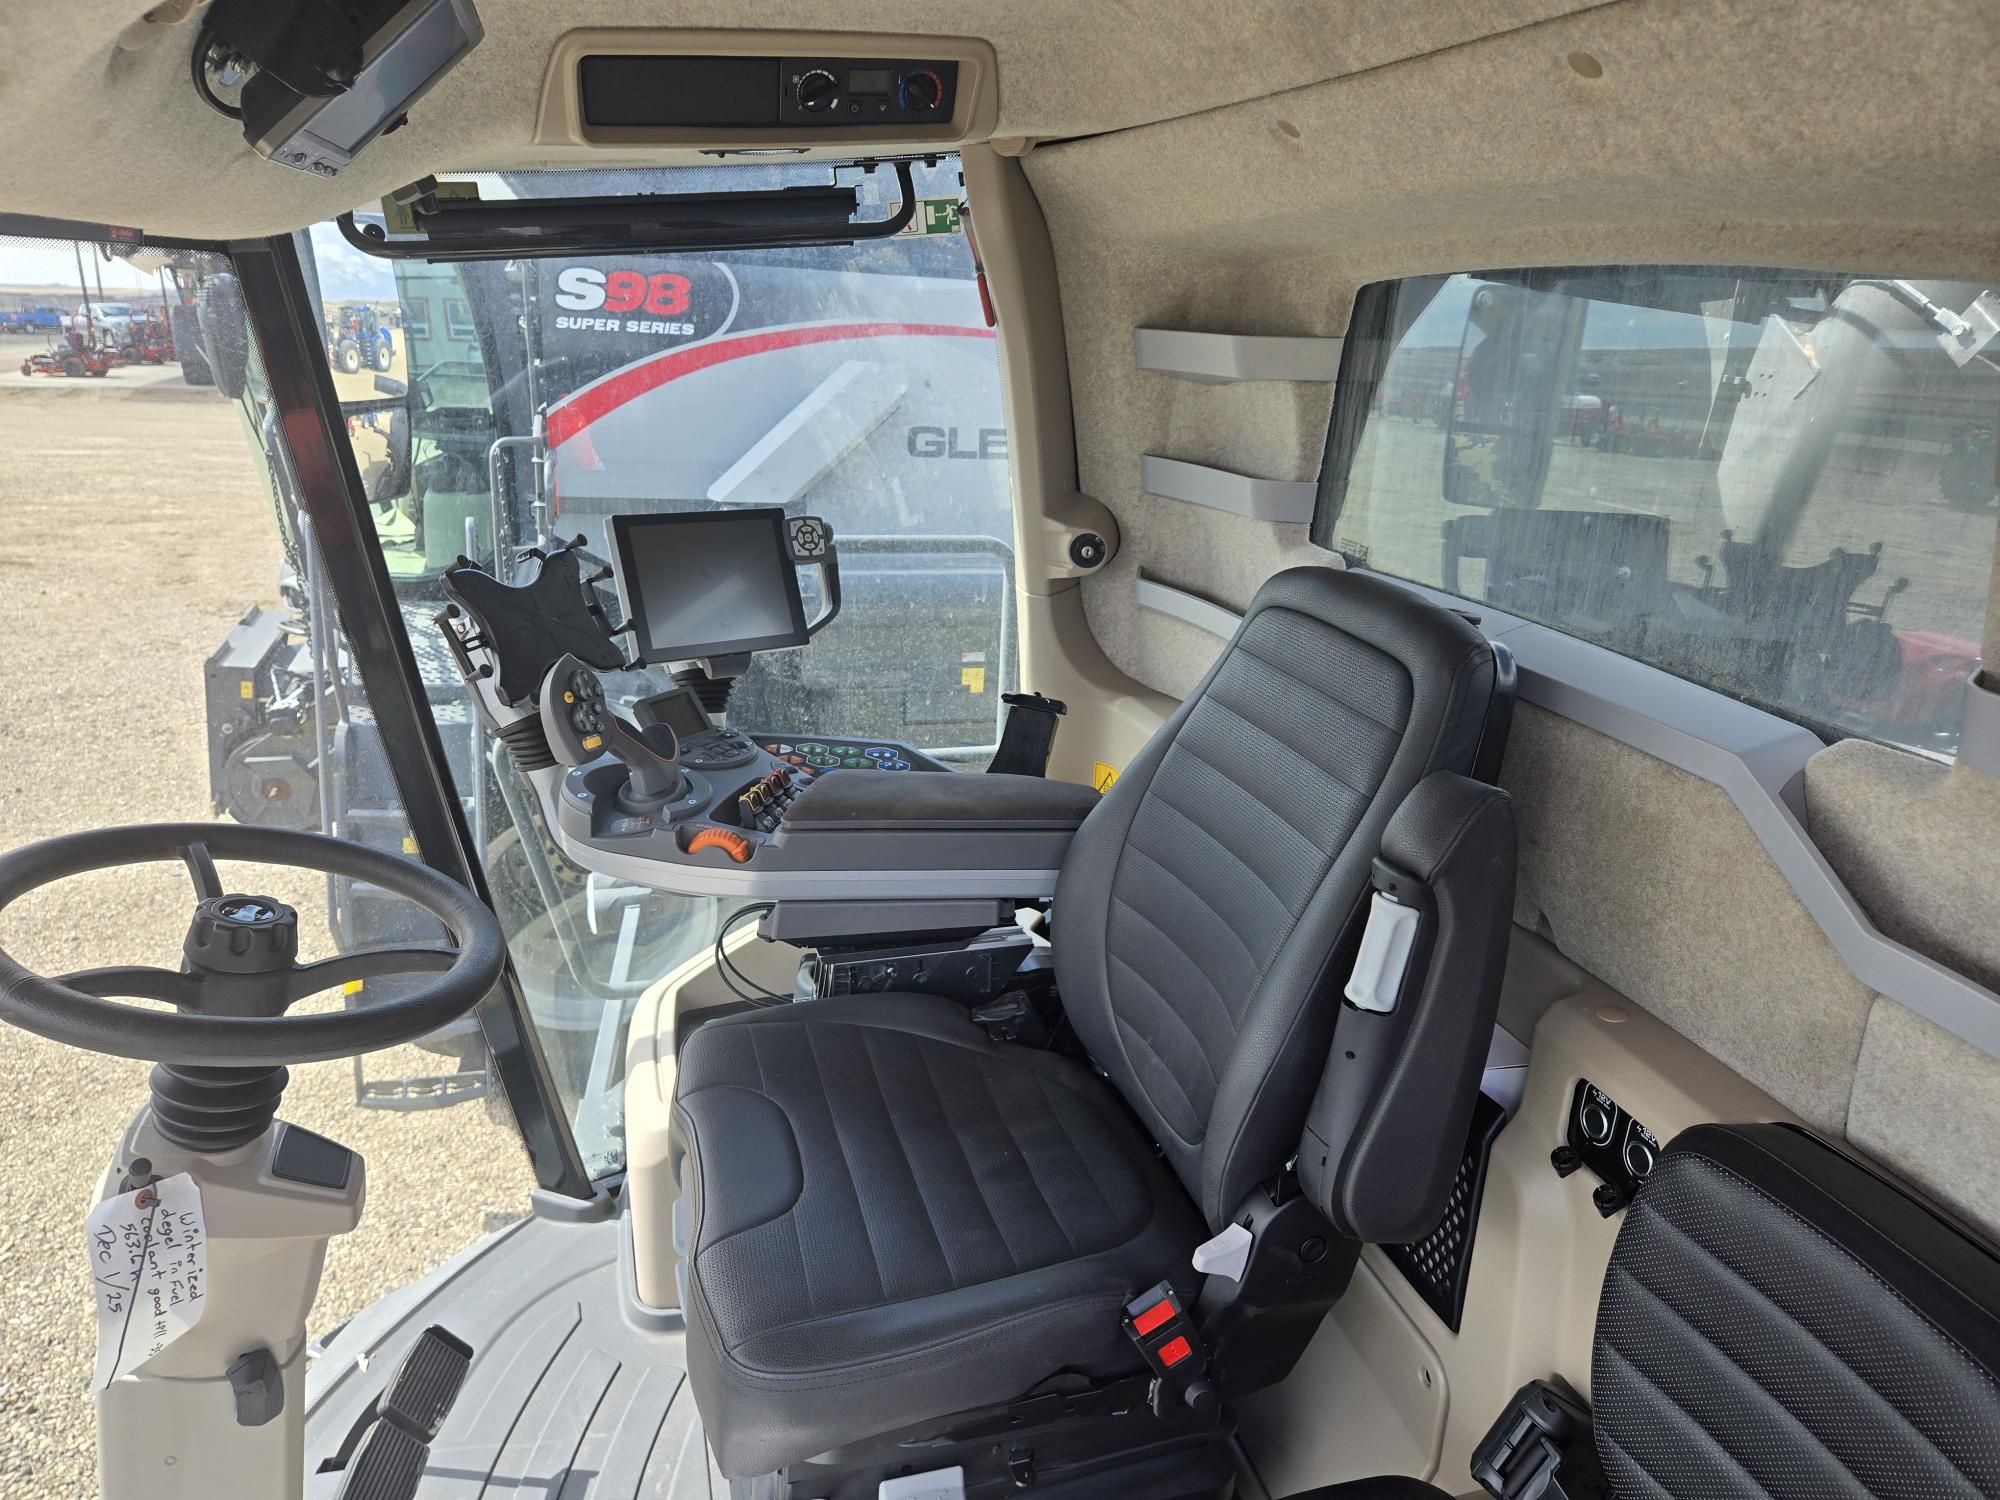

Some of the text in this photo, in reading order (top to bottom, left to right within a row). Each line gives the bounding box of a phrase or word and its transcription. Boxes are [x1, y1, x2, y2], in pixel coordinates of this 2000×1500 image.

[555, 267, 692, 316] S98
[555, 316, 695, 336] SUPER SERIES
[907, 426, 1008, 460] GLE
[1598, 1091, 1611, 1106] 12V
[1642, 1128, 1657, 1142] 12V
[93, 1224, 117, 1264] Dec
[156, 1209, 185, 1306] degel in Fuel
[179, 1211, 204, 1303] Winterized
[147, 1287, 167, 1319] good
[153, 1320, 167, 1340] till
